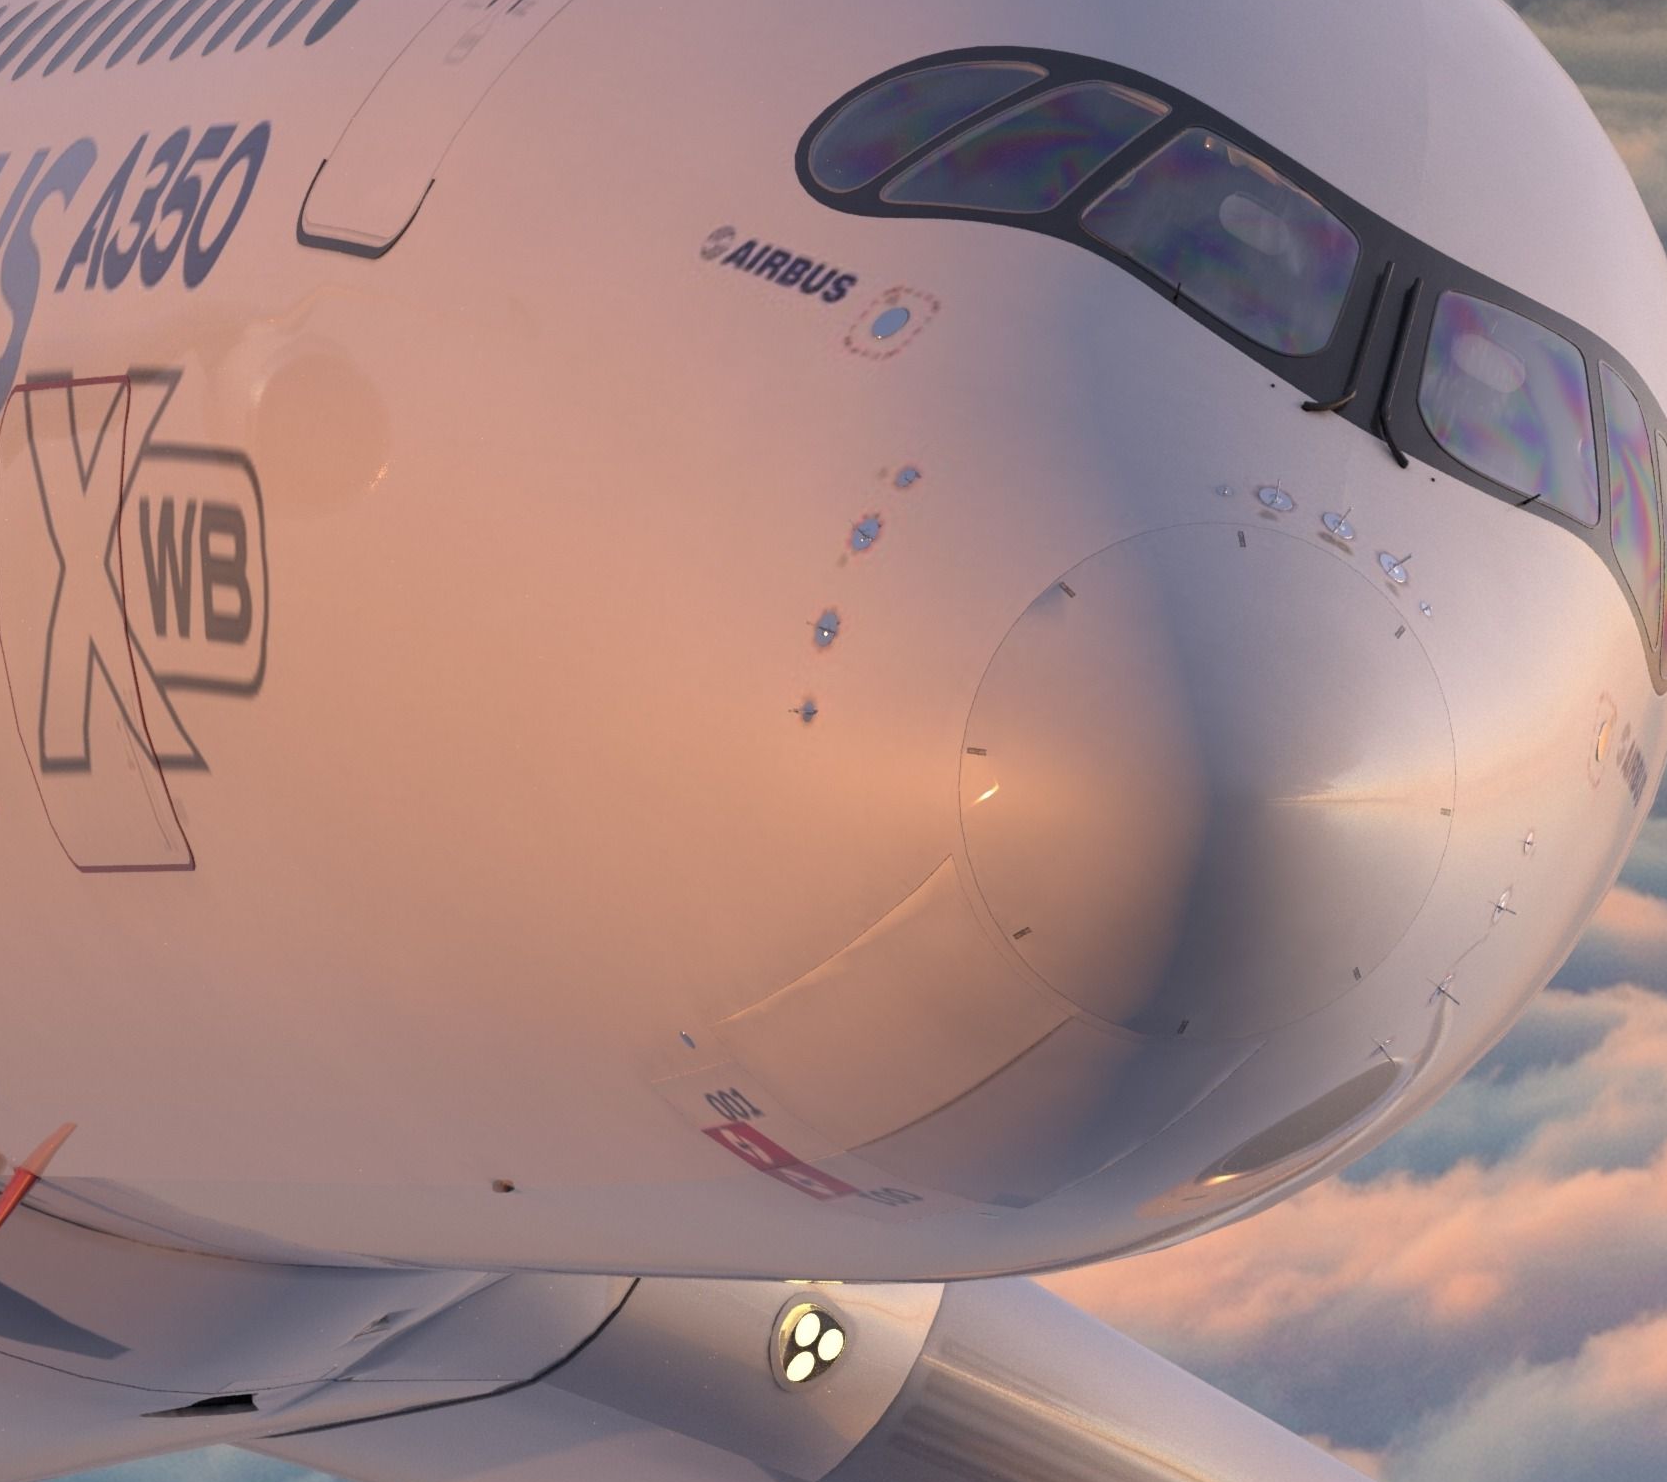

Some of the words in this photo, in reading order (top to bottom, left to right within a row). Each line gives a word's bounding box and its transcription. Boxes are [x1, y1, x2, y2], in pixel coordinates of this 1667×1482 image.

[54, 122, 270, 292] A350
[721, 239, 857, 303] AIRBUS
[705, 1087, 763, 1121] 001
